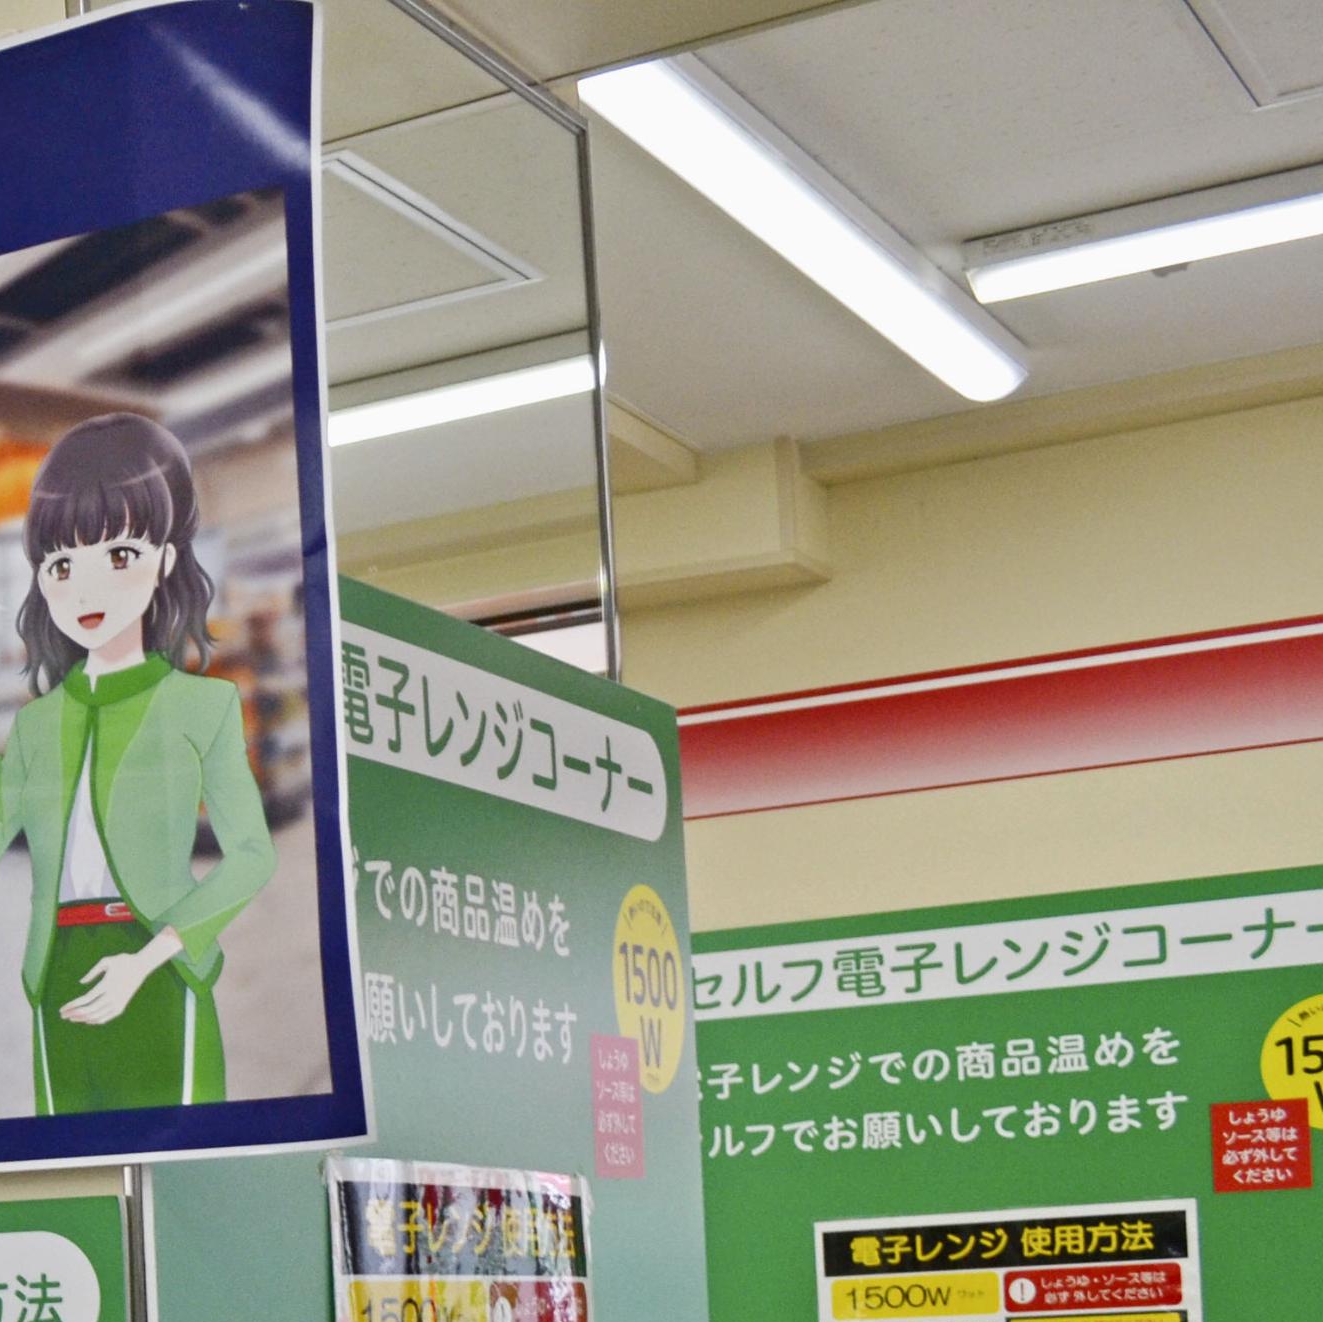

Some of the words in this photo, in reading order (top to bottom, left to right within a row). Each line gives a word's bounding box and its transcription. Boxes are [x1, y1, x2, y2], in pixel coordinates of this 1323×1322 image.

[341, 643, 653, 812] 電子レンジコーナー
[352, 846, 571, 957] での商品温めを
[619, 941, 677, 1010] 1500
[640, 1015, 661, 1068] W
[698, 1027, 1180, 1100] 子レンジでの商品温めを
[700, 1091, 1187, 1159] ルフでお願いしております
[1222, 1128, 1298, 1145] ソース等は
[1228, 1108, 1286, 1125] しょうゆ
[1222, 1147, 1298, 1165] 必ず外して
[1233, 1168, 1292, 1184] ください
[850, 1228, 1007, 1265] 電子レンジ
[1021, 1220, 1154, 1256] 使用方法
[846, 1284, 951, 1310] 1500W
